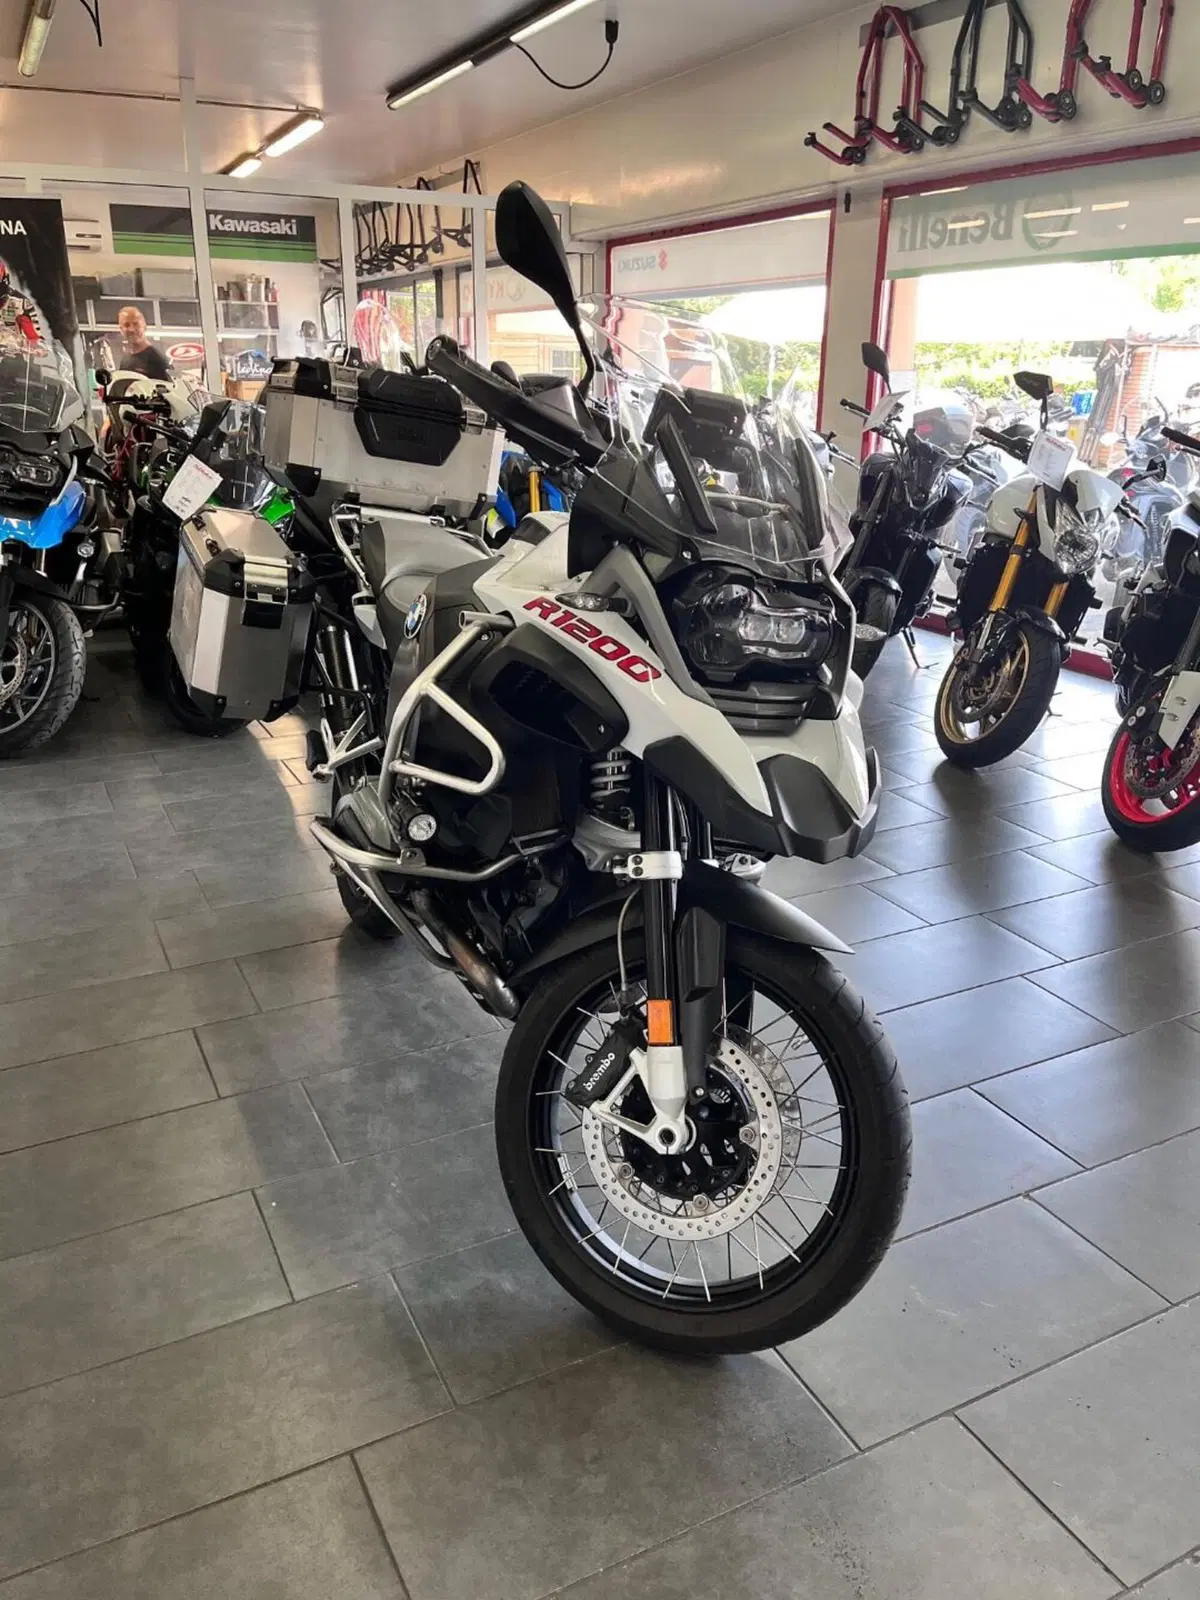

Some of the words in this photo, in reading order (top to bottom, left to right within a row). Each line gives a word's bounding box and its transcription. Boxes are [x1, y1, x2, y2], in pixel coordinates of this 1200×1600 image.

[0, 219, 28, 235] NA
[208, 213, 298, 235] Kawasaki
[522, 596, 662, 683] R1200
[582, 1052, 615, 1091] brembo
